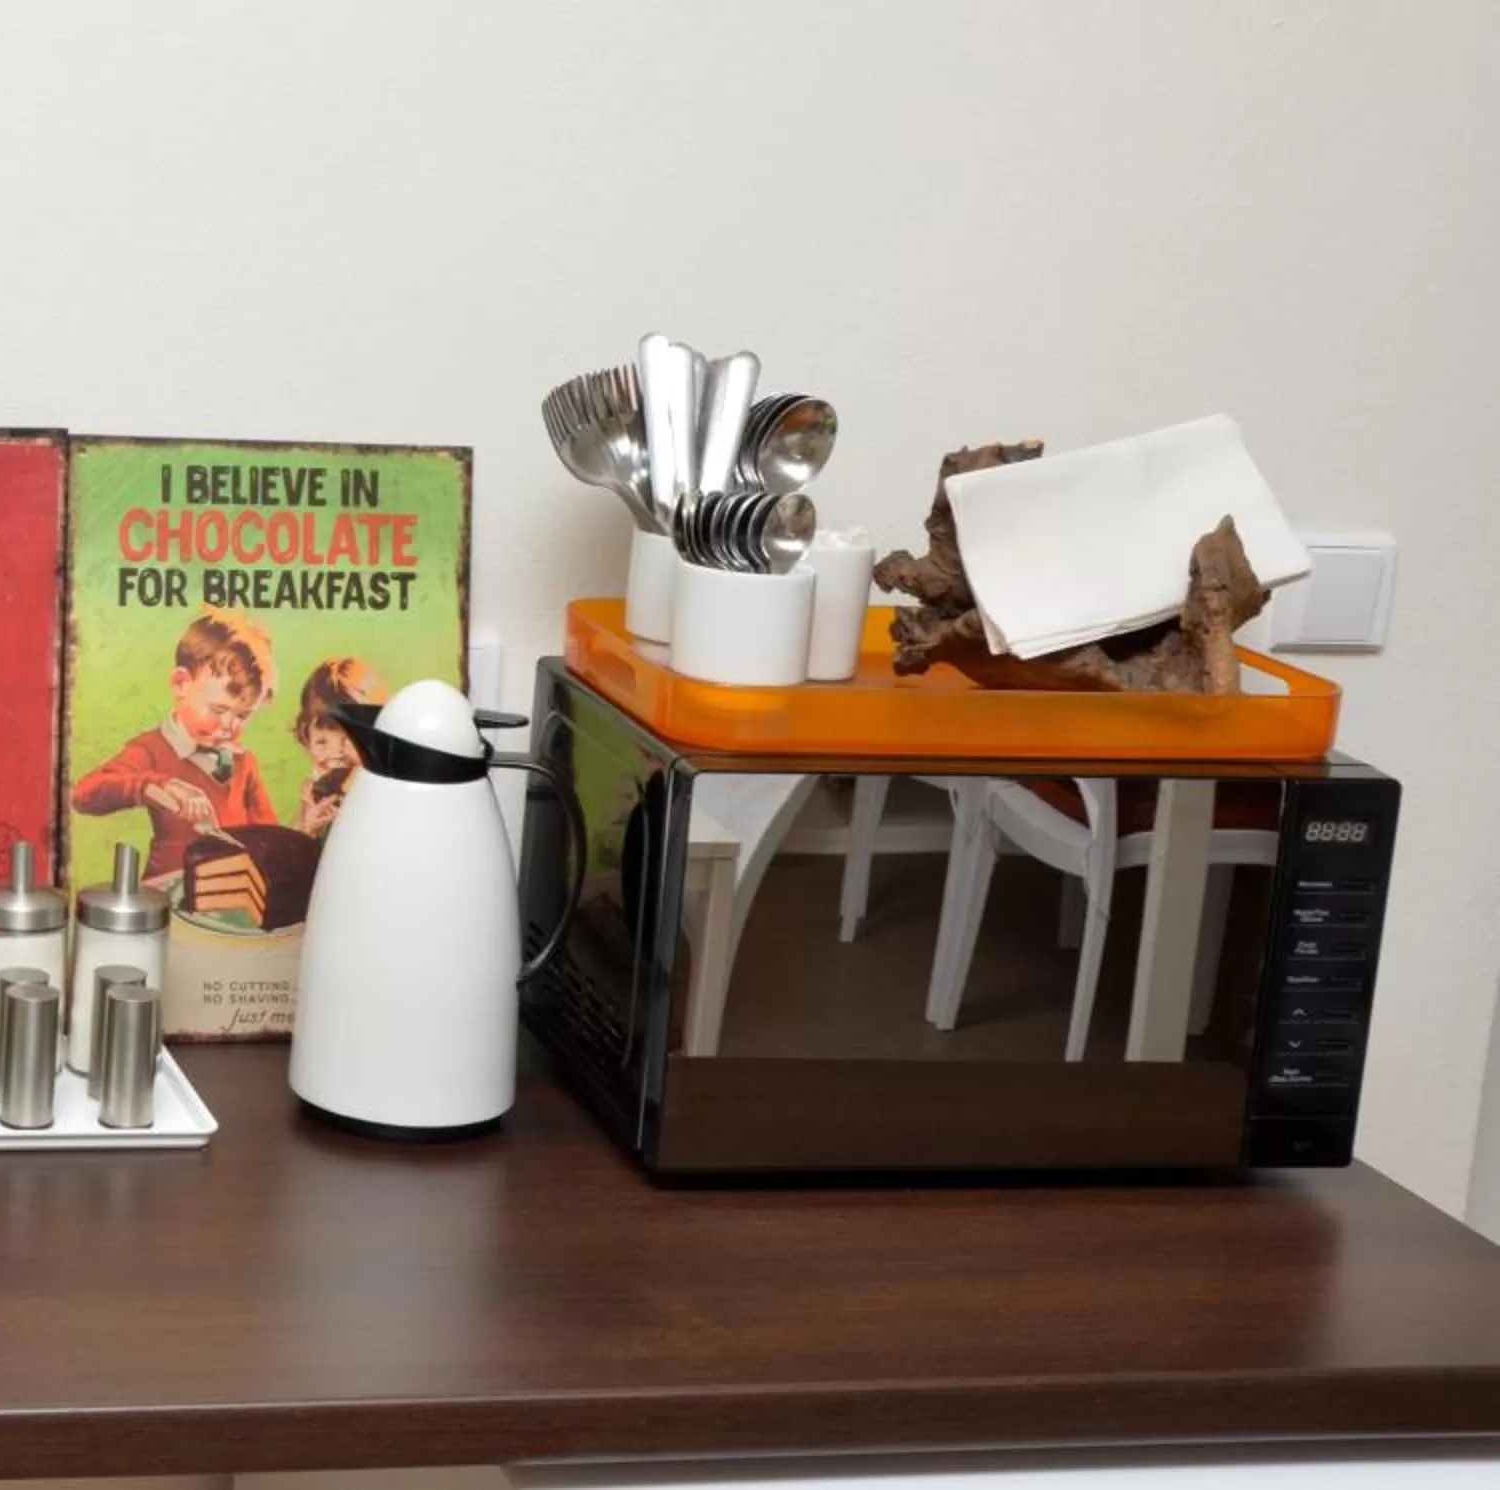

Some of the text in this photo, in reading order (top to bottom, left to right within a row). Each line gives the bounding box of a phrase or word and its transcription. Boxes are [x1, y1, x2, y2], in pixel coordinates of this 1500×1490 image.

[160, 463, 381, 508] I BELIEVE IN
[118, 507, 420, 567] CHOCOLATE
[118, 567, 418, 611] FOR BREAKFAST
[202, 980, 223, 992] NO
[202, 993, 223, 1005] NO
